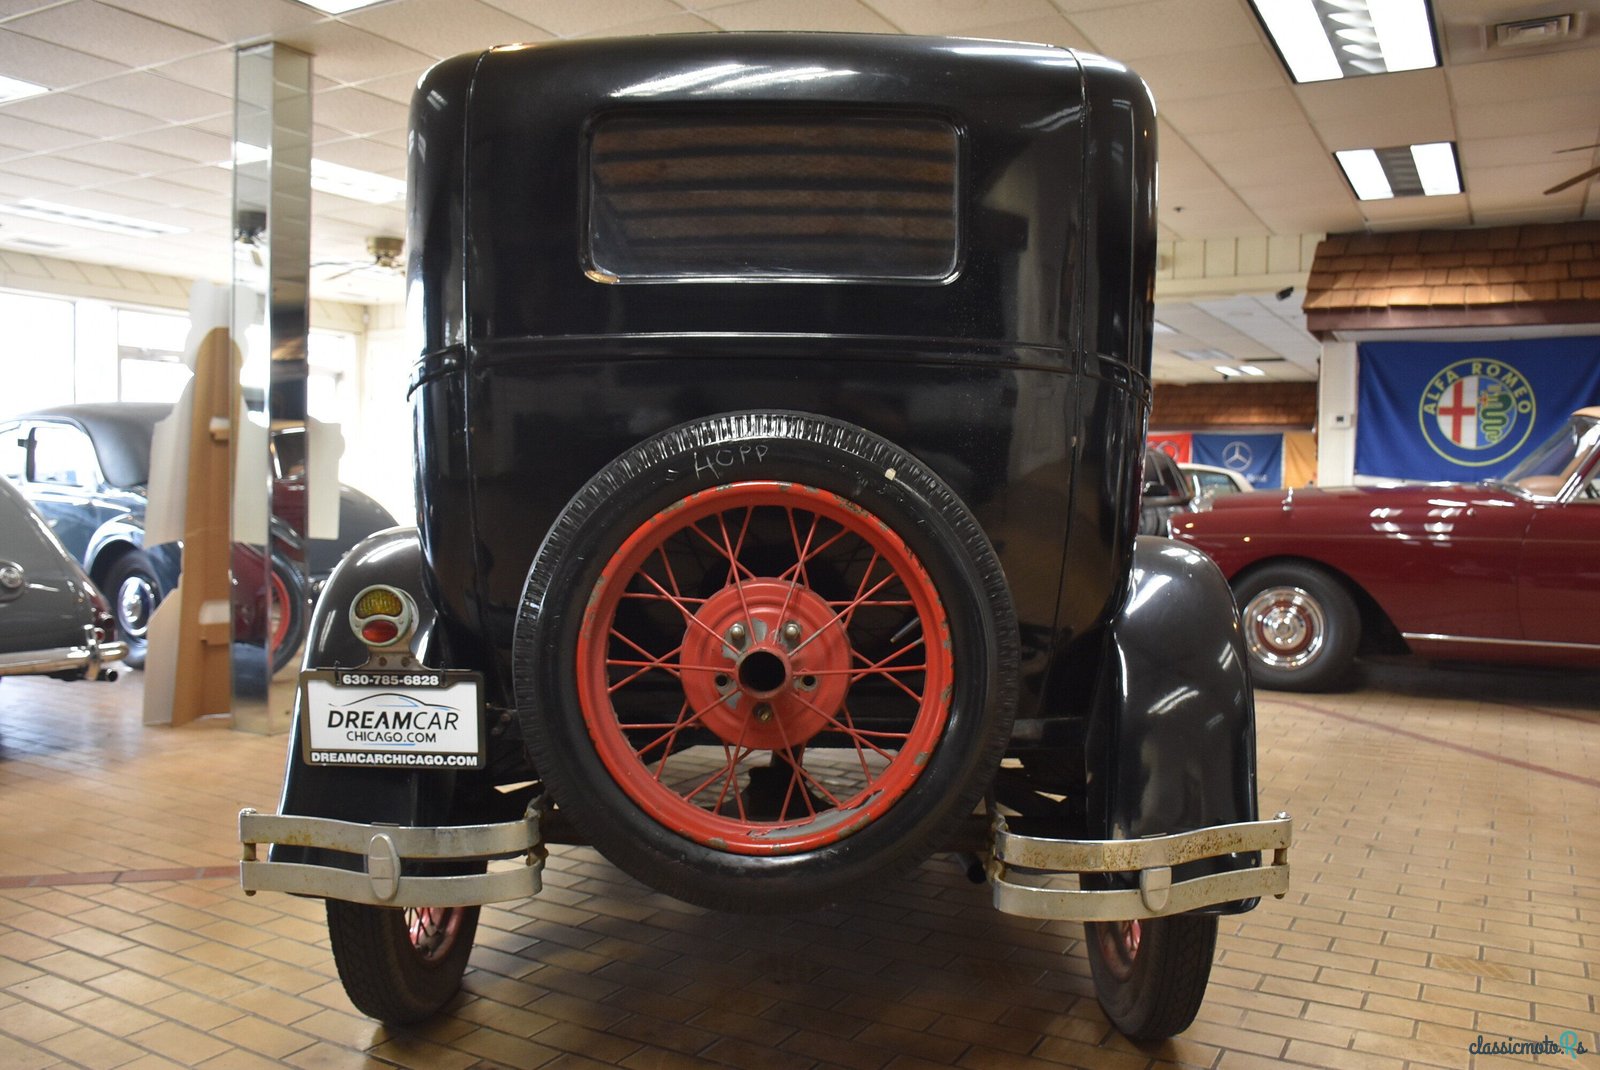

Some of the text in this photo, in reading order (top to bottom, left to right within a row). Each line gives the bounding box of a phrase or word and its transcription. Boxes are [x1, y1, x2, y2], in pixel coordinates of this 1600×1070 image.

[1423, 362, 1532, 415] ALFA ROMEO
[342, 674, 439, 686] 630-785-6828
[327, 710, 459, 730] DREAMCAR
[346, 731, 437, 743] CHICAGO.COM
[311, 752, 478, 766] DREAMCARCHICAGO.COM
